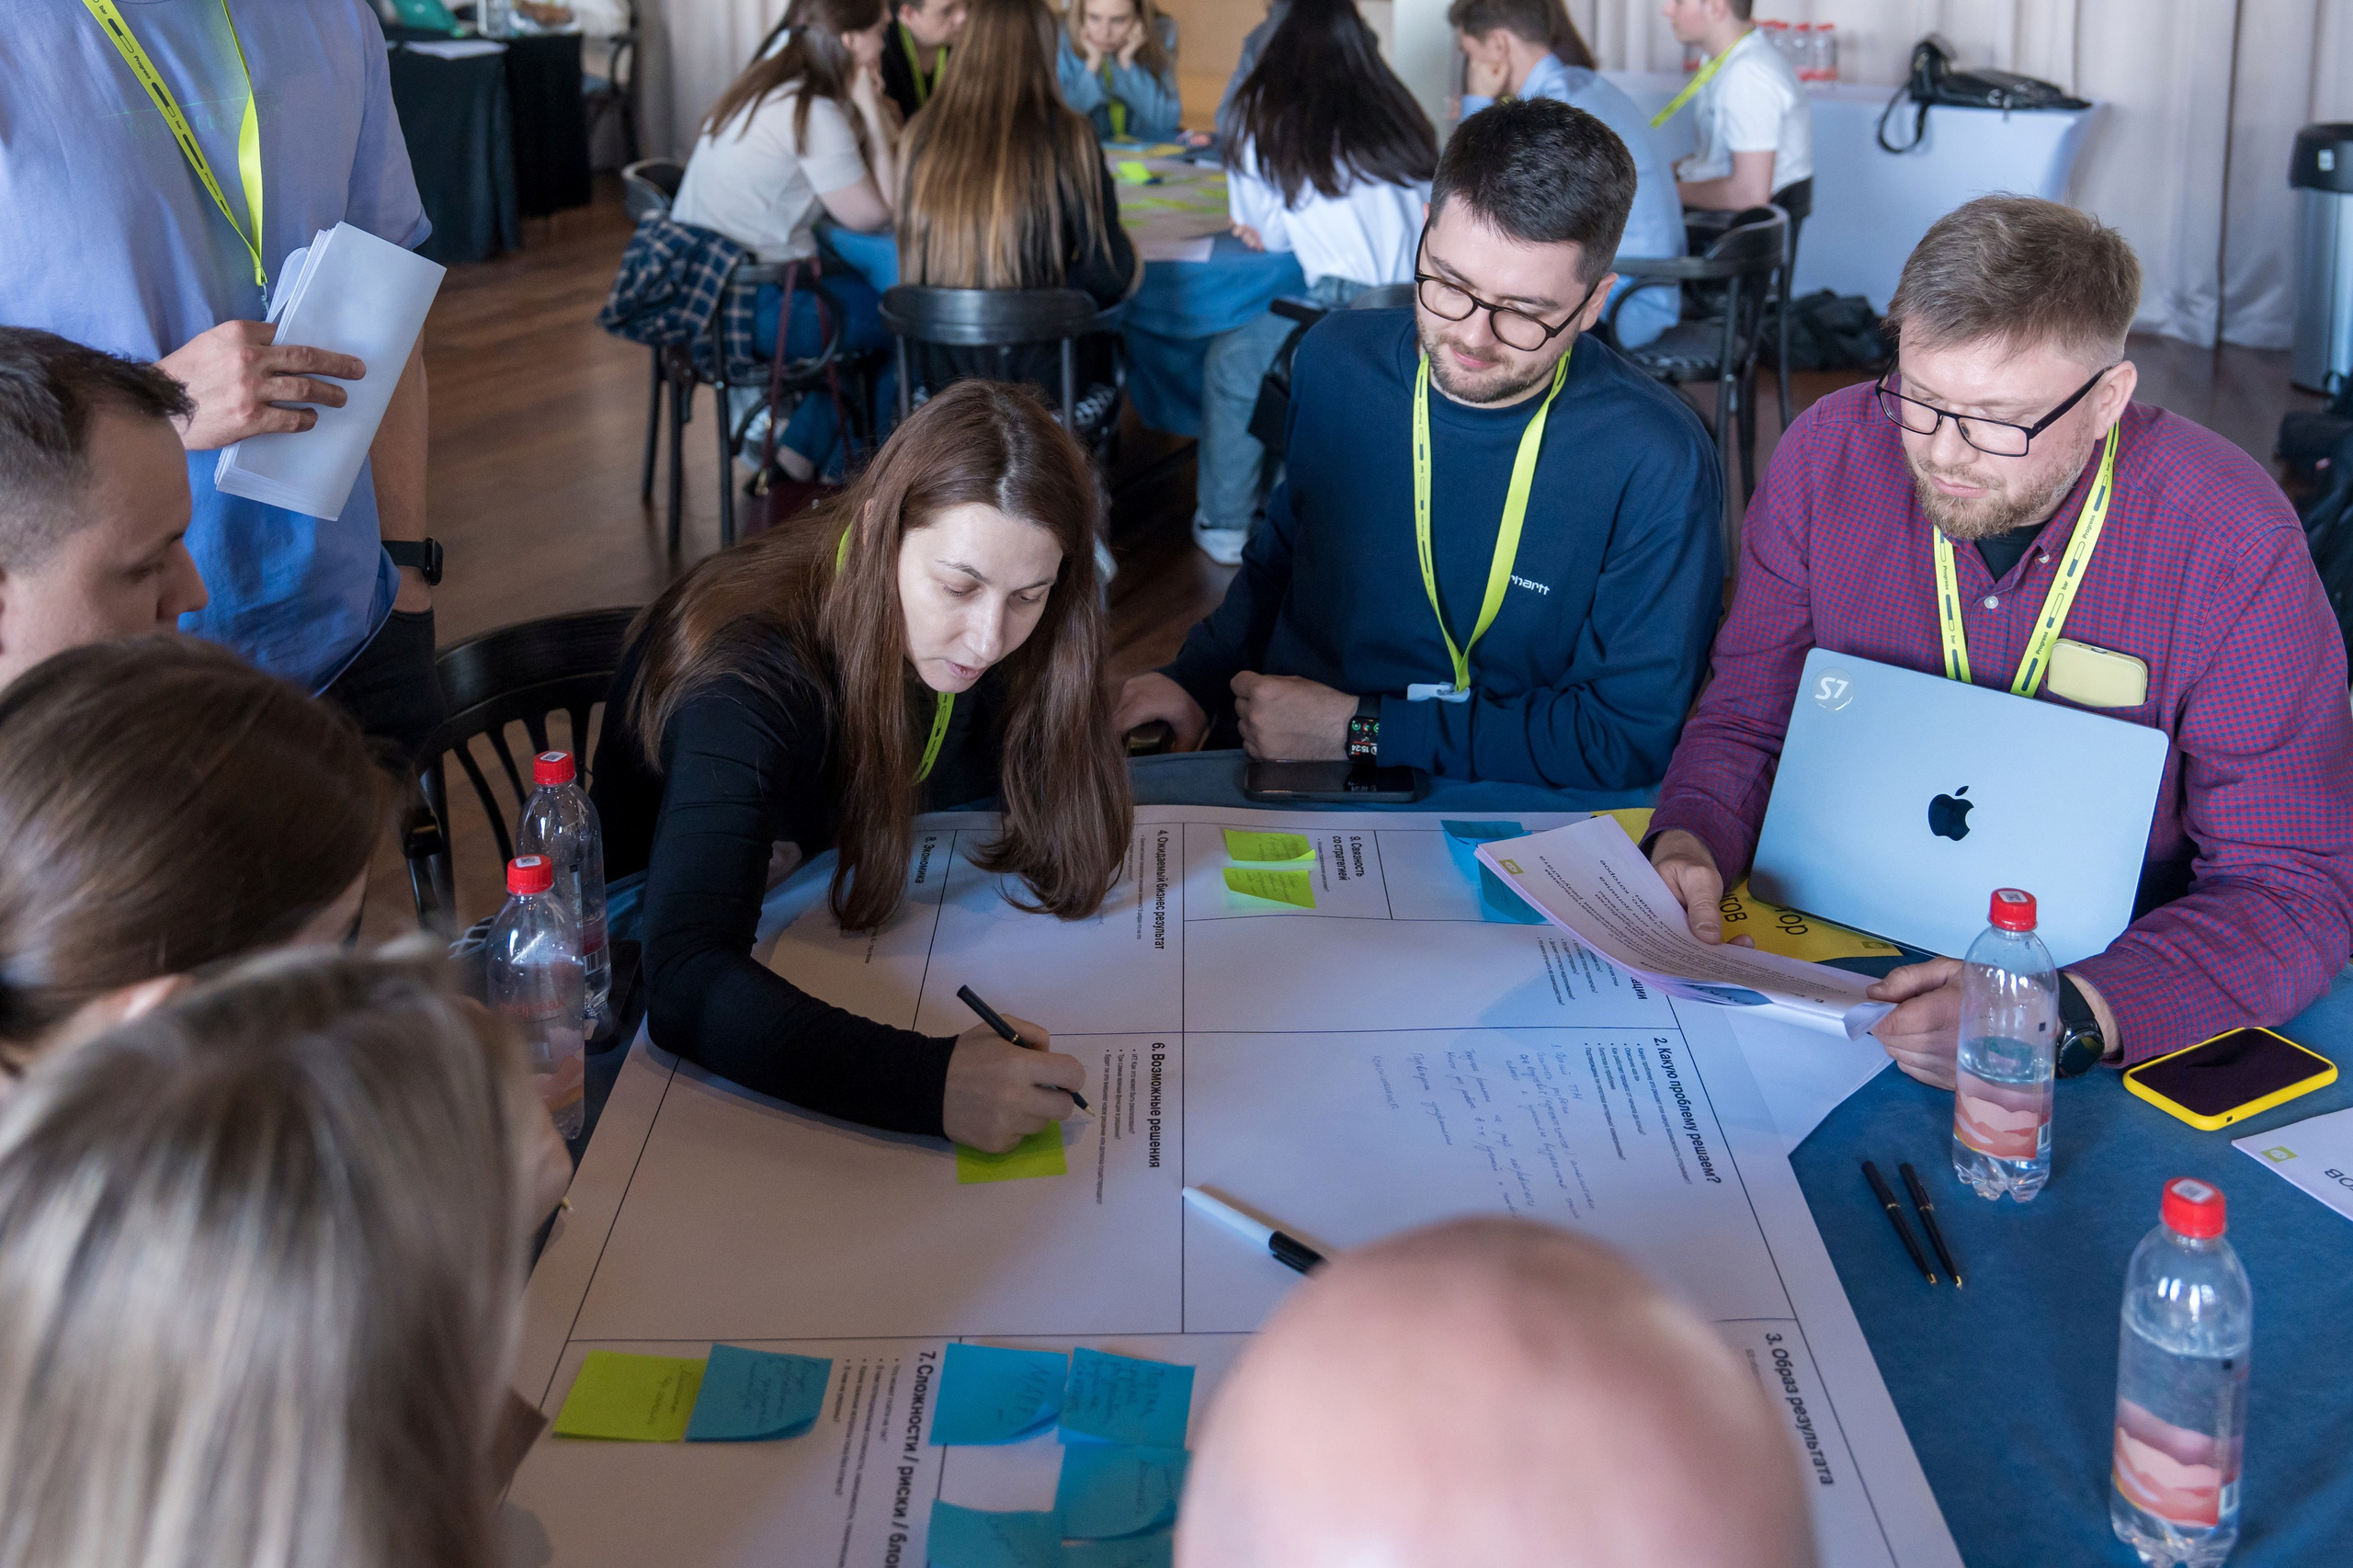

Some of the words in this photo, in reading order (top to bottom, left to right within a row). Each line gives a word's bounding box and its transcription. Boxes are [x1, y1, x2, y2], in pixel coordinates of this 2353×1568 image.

[98, 4, 107, 14] bar
[134, 54, 150, 80] Progress
[174, 119, 182, 130] bar
[204, 172, 219, 196] Progress
[2035, 631, 2048, 654] Progress
[2060, 580, 2068, 591] bar
[2082, 514, 2095, 539] Progress
[1813, 675, 1849, 703] S7
[1351, 744, 1370, 754] 15:24
[1332, 835, 1342, 844] со
[915, 843, 936, 884] Экономика
[1155, 836, 1168, 882] Ожидаемый
[1333, 844, 1350, 881] стратегией
[1350, 842, 1365, 877] Связность
[1599, 859, 1630, 894] которое
[1539, 855, 1584, 901] результата
[1598, 876, 1632, 912] допилка
[1155, 883, 1167, 910] бизнес
[1631, 896, 1663, 929] старого,
[1634, 894, 1658, 919] задач.
[1153, 911, 1165, 949] результат
[1631, 913, 1649, 927] или
[1151, 1041, 1165, 1051] 6.
[1624, 1047, 1636, 1067] Описание
[1653, 1037, 1668, 1046] 2.
[1103, 1053, 1111, 1067] Будет
[1598, 1047, 1608, 1065] Гипотеза
[1605, 1069, 1617, 1090] проблеме
[1658, 1048, 1678, 1078] Какую
[1150, 1053, 1165, 1117] Возможные
[1612, 1054, 1625, 1074] работает
[1620, 1074, 1631, 1092] процесс
[1628, 1097, 1638, 1113] начала
[1634, 1119, 1646, 1135] конца?
[1637, 1047, 1646, 1060] Какую
[1642, 1061, 1654, 1080] проблему
[1651, 1088, 1662, 1105] решает
[1660, 1114, 1670, 1127] какую
[1665, 1128, 1681, 1156] возможность
[1128, 1102, 1136, 1135] реализовано?
[1586, 1047, 1599, 1077] Подтверждена
[1597, 1084, 1607, 1103] гипотеза
[1609, 1127, 1626, 1160] измерениями?
[1669, 1080, 1698, 1131] проблему
[1147, 1118, 1161, 1168] решения
[1687, 1132, 1722, 1184] решаем?
[918, 1350, 937, 1361] 7.
[1766, 1332, 1782, 1346] 3.
[1770, 1347, 1799, 1393] Образ
[904, 1364, 934, 1451] Сложности
[1786, 1396, 1835, 1485] результата
[893, 1465, 915, 1517] риски
[892, 1521, 909, 1529] /
